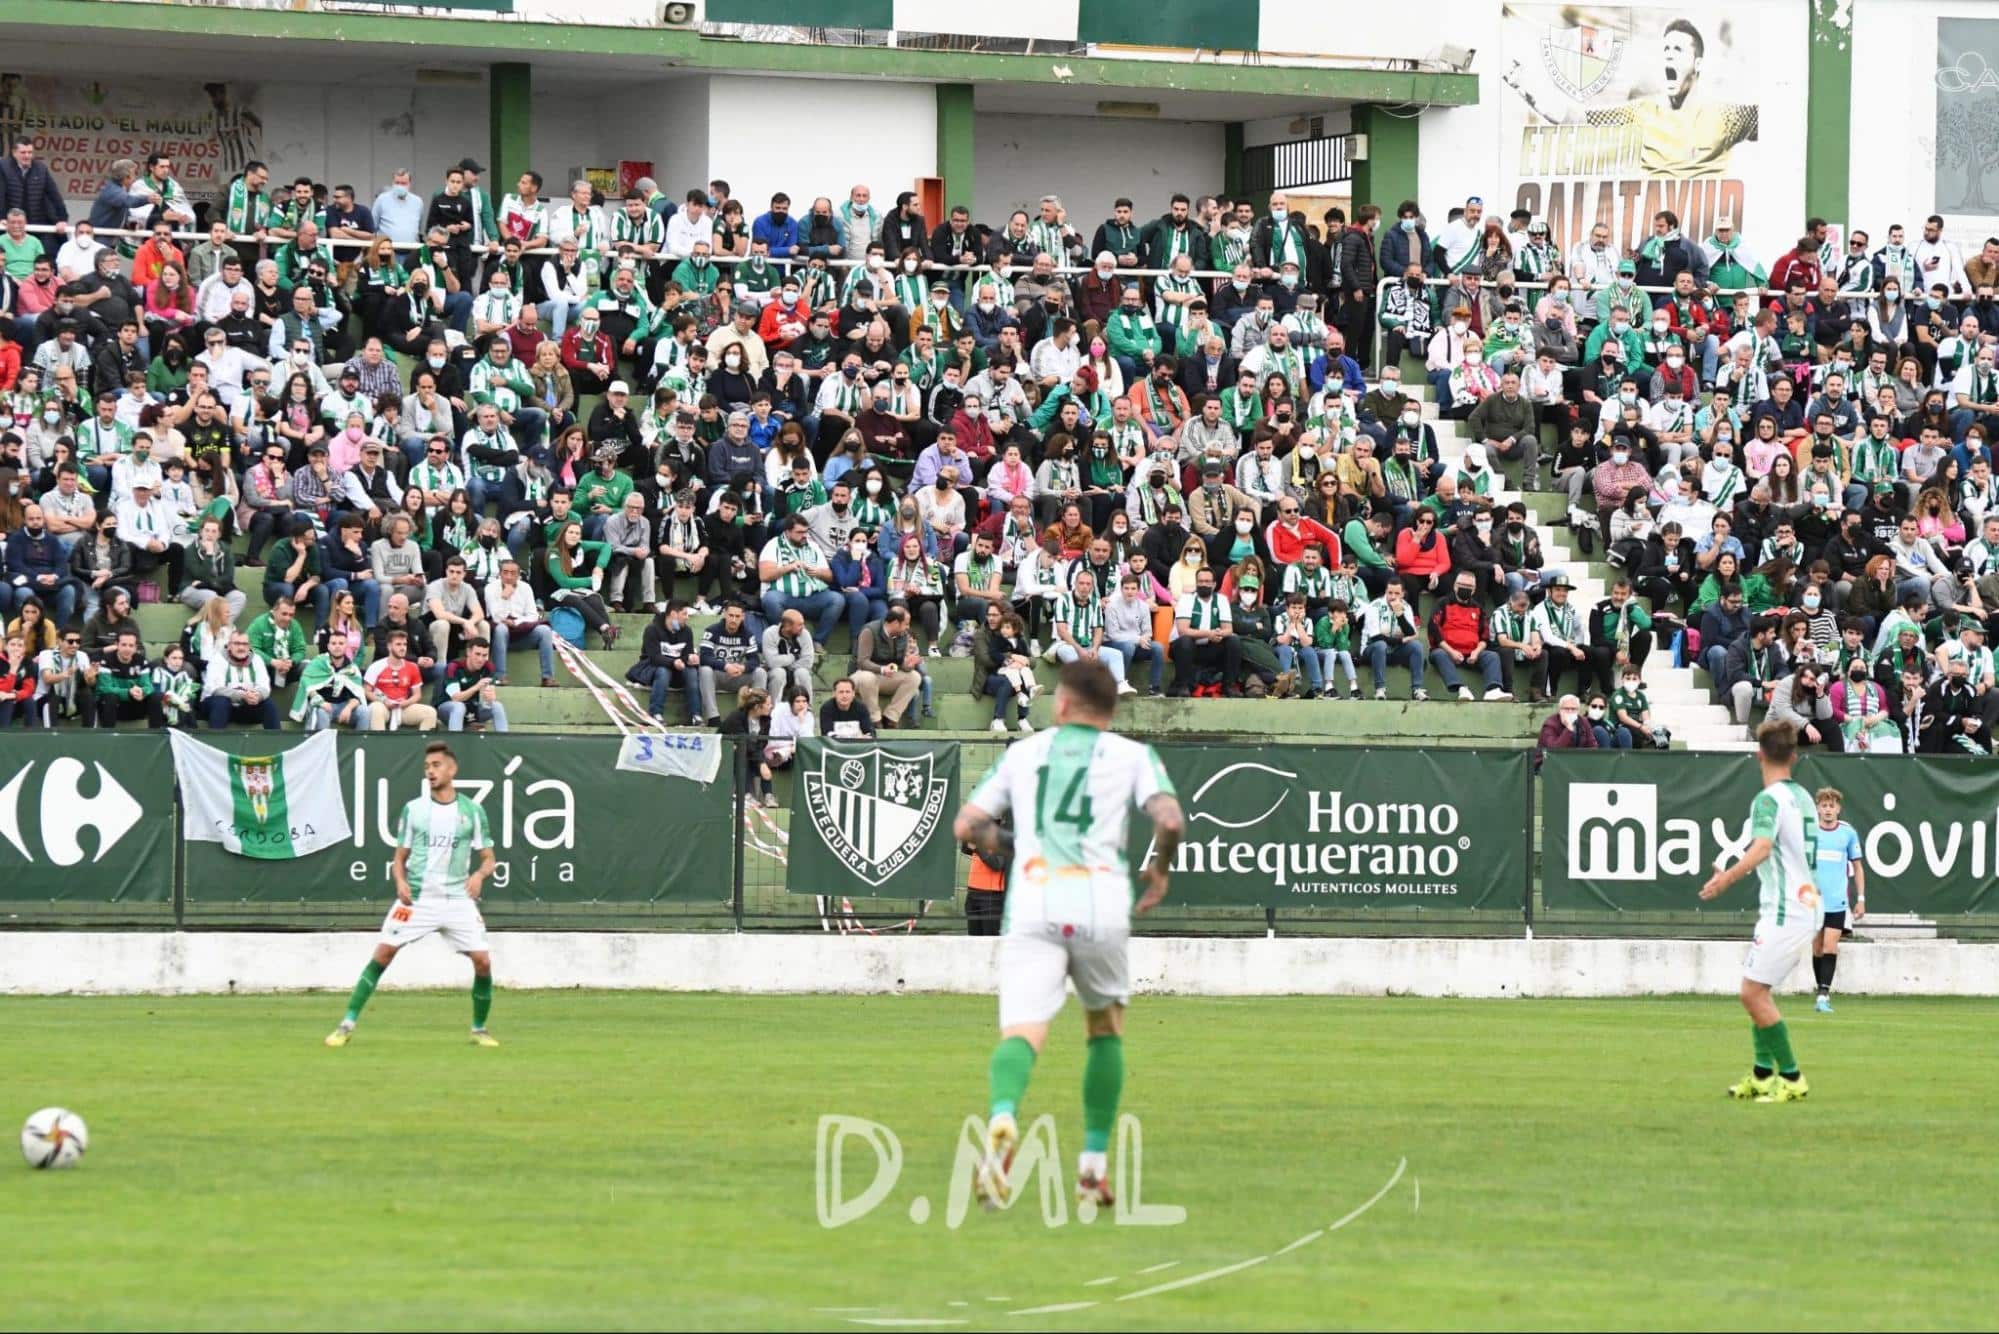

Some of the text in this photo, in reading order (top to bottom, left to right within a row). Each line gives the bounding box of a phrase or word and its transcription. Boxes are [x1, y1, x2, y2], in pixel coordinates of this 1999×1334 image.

[24, 113, 104, 131] ESTADIO
[33, 134, 88, 153] ONDE
[94, 137, 135, 154] LOS
[185, 163, 213, 178] EN
[354, 747, 575, 850] luzía
[1035, 764, 1095, 835] 14
[1308, 790, 1460, 836] Horno
[808, 780, 943, 877] ANTEQUERA CLUB DE FUTBOL
[1291, 882, 1458, 896] AUTENTICOS MOLLETES
